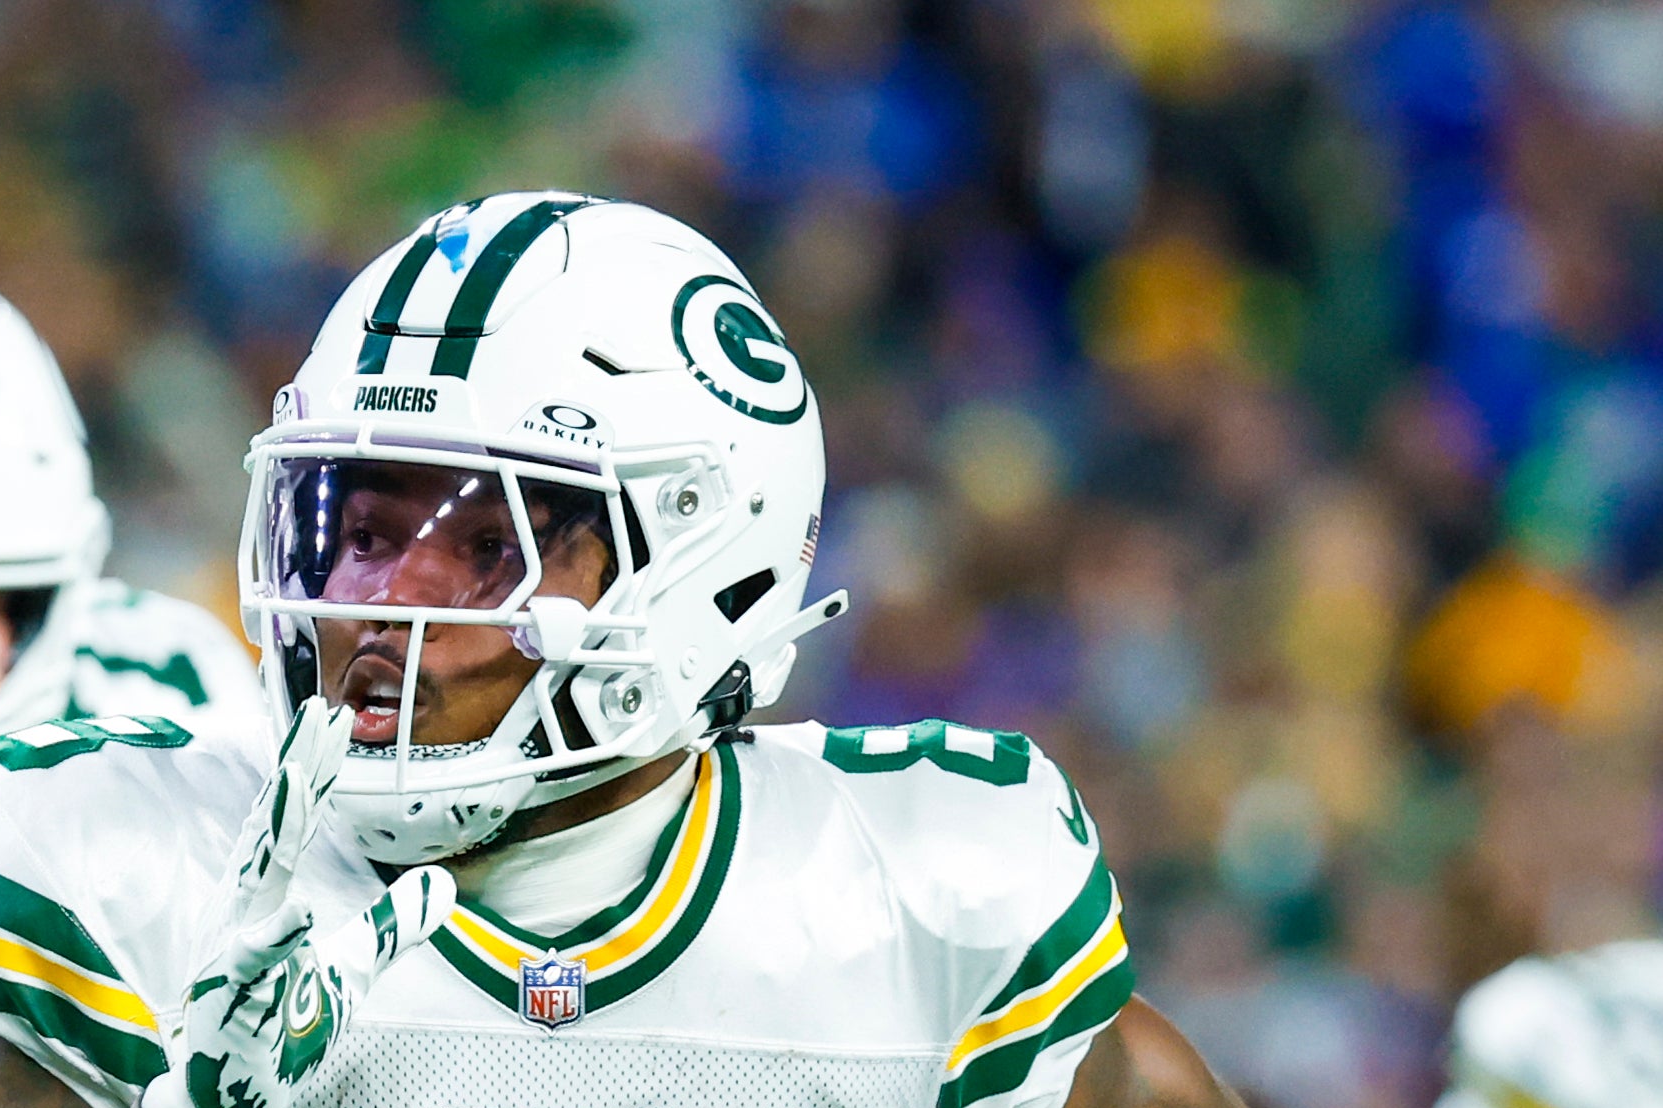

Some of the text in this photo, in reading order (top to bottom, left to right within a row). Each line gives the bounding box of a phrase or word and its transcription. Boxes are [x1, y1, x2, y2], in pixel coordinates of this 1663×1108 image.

[353, 385, 438, 413] PACKERS
[523, 420, 605, 449] OAKLEY
[528, 988, 576, 1022] NFL
